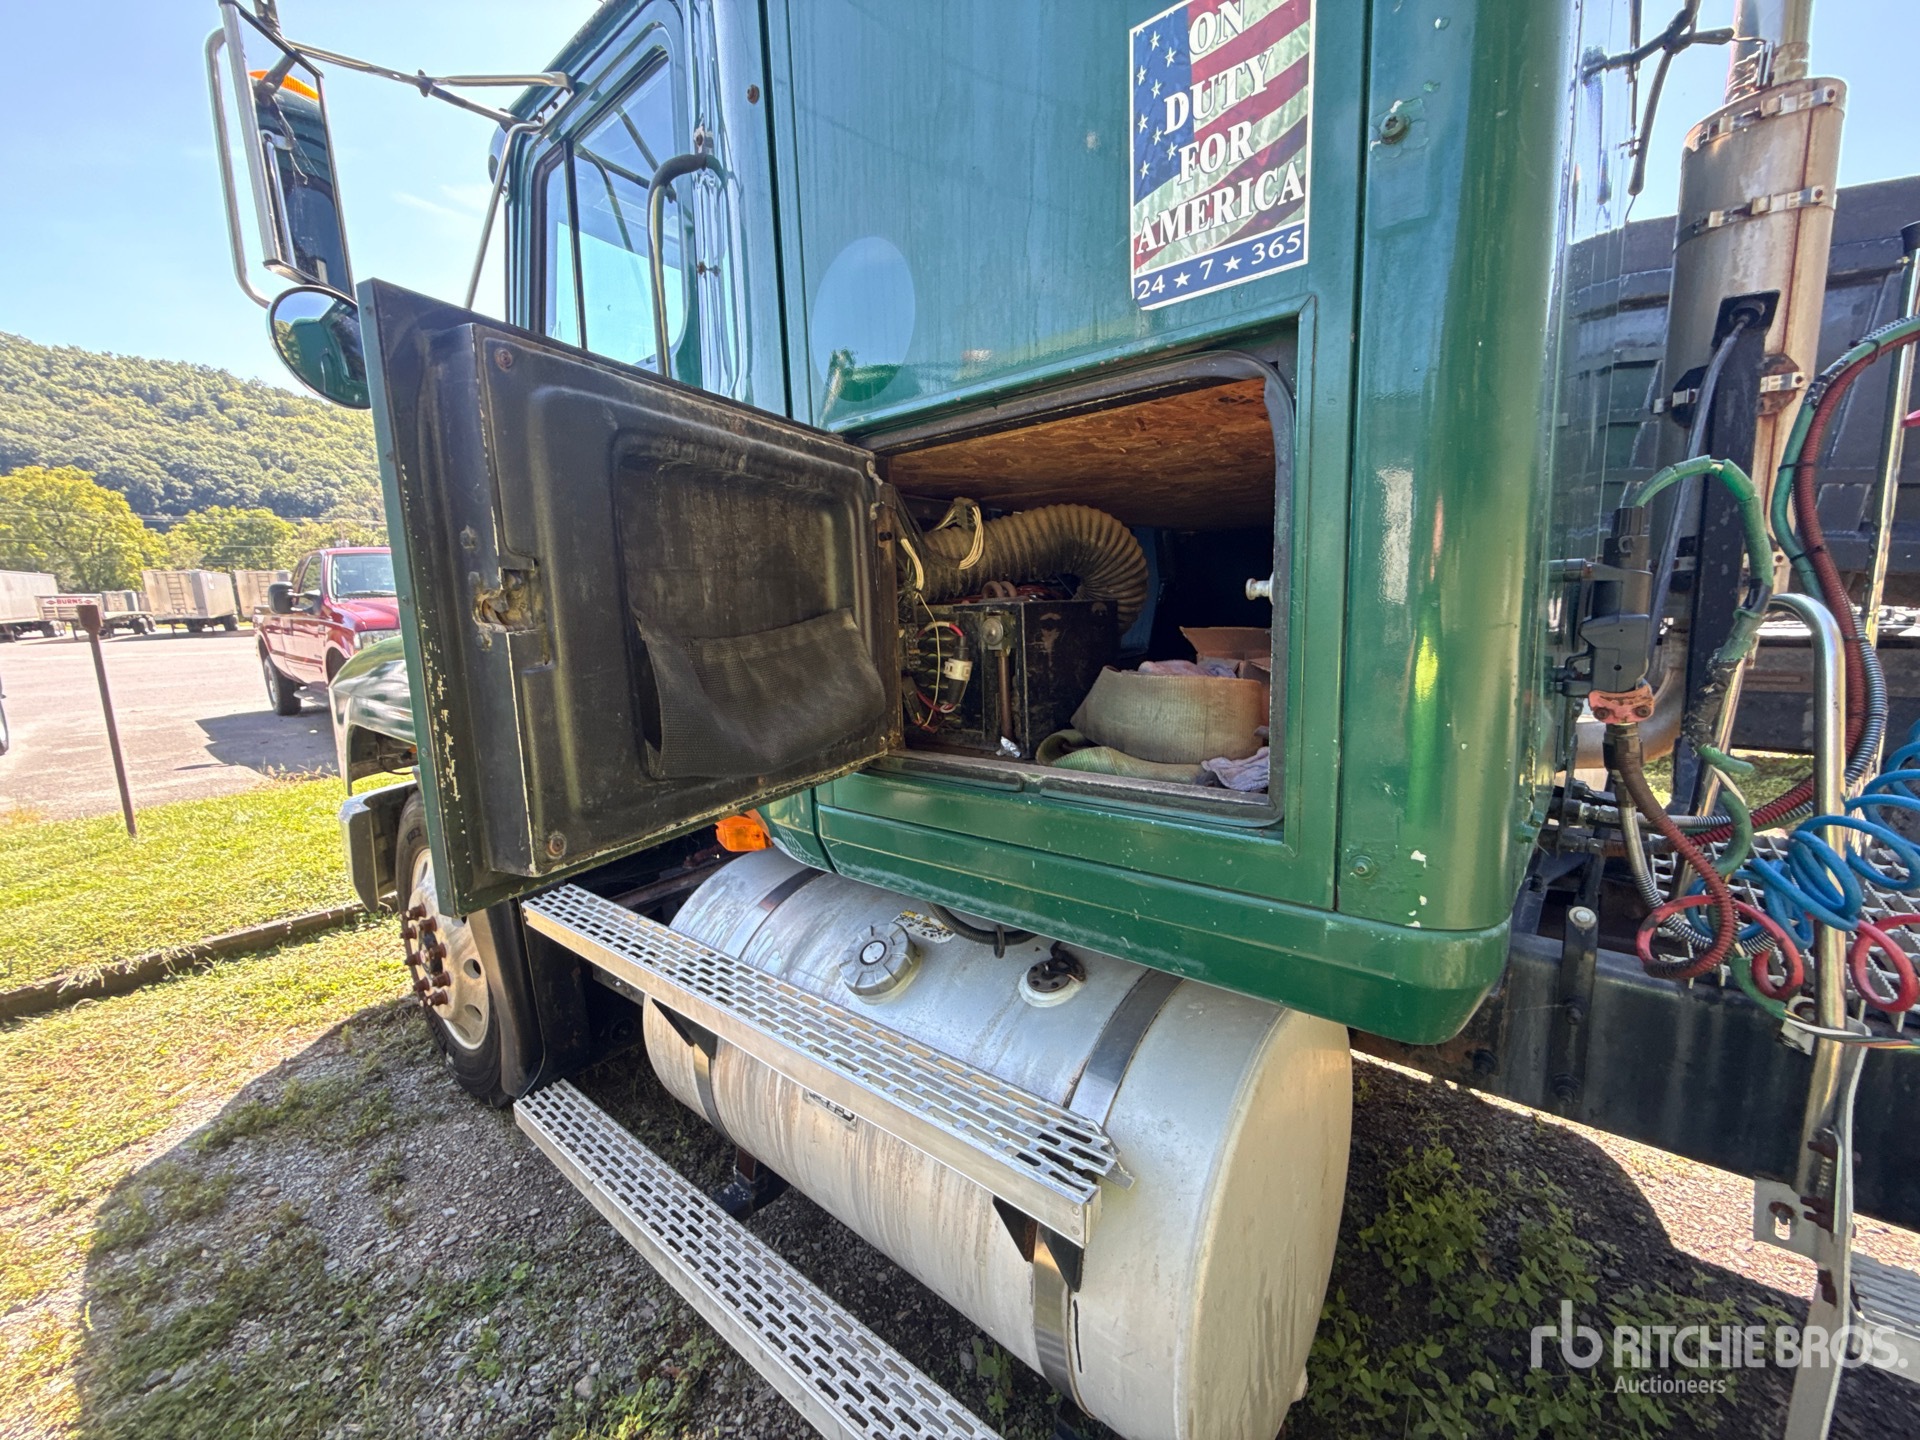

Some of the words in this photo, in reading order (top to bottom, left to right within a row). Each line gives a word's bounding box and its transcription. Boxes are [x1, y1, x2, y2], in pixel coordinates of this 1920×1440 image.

[1188, 0, 1245, 54] ON
[1163, 48, 1273, 135] DUTY
[1177, 120, 1254, 186] FOR
[1136, 161, 1304, 254] AMERICA
[1137, 278, 1165, 299] 24
[1199, 259, 1214, 280] 7
[1251, 229, 1301, 265] 365
